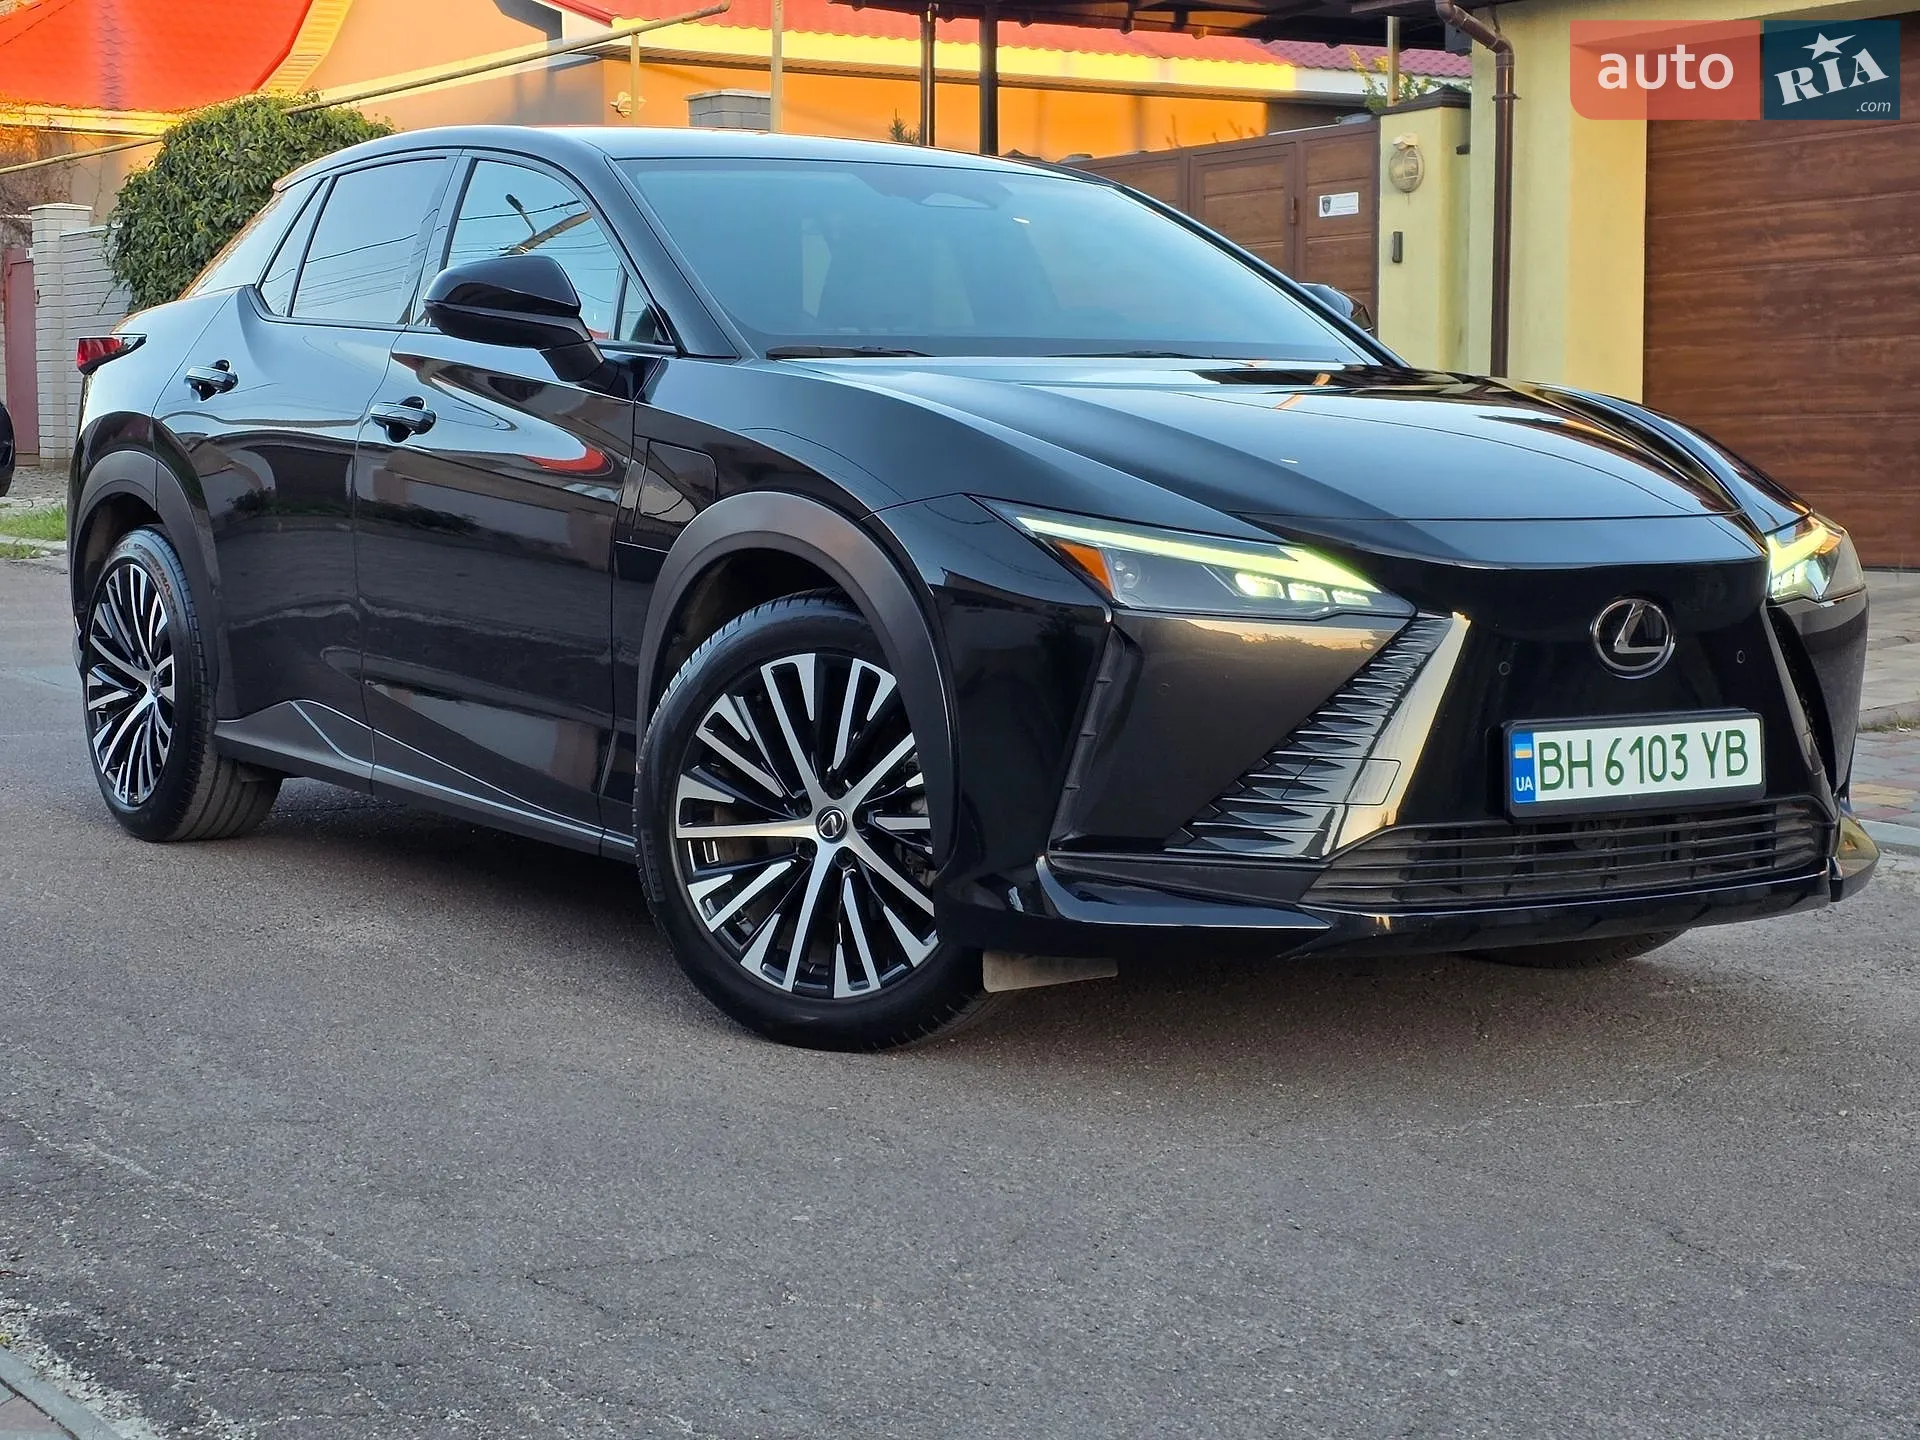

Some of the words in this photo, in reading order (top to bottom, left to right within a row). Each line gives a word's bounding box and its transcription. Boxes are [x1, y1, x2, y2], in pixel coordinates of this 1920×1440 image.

[1538, 739, 1594, 792] BH
[1604, 735, 1690, 786] 6103
[1701, 729, 1749, 779] YB
[1515, 775, 1534, 792] UA
